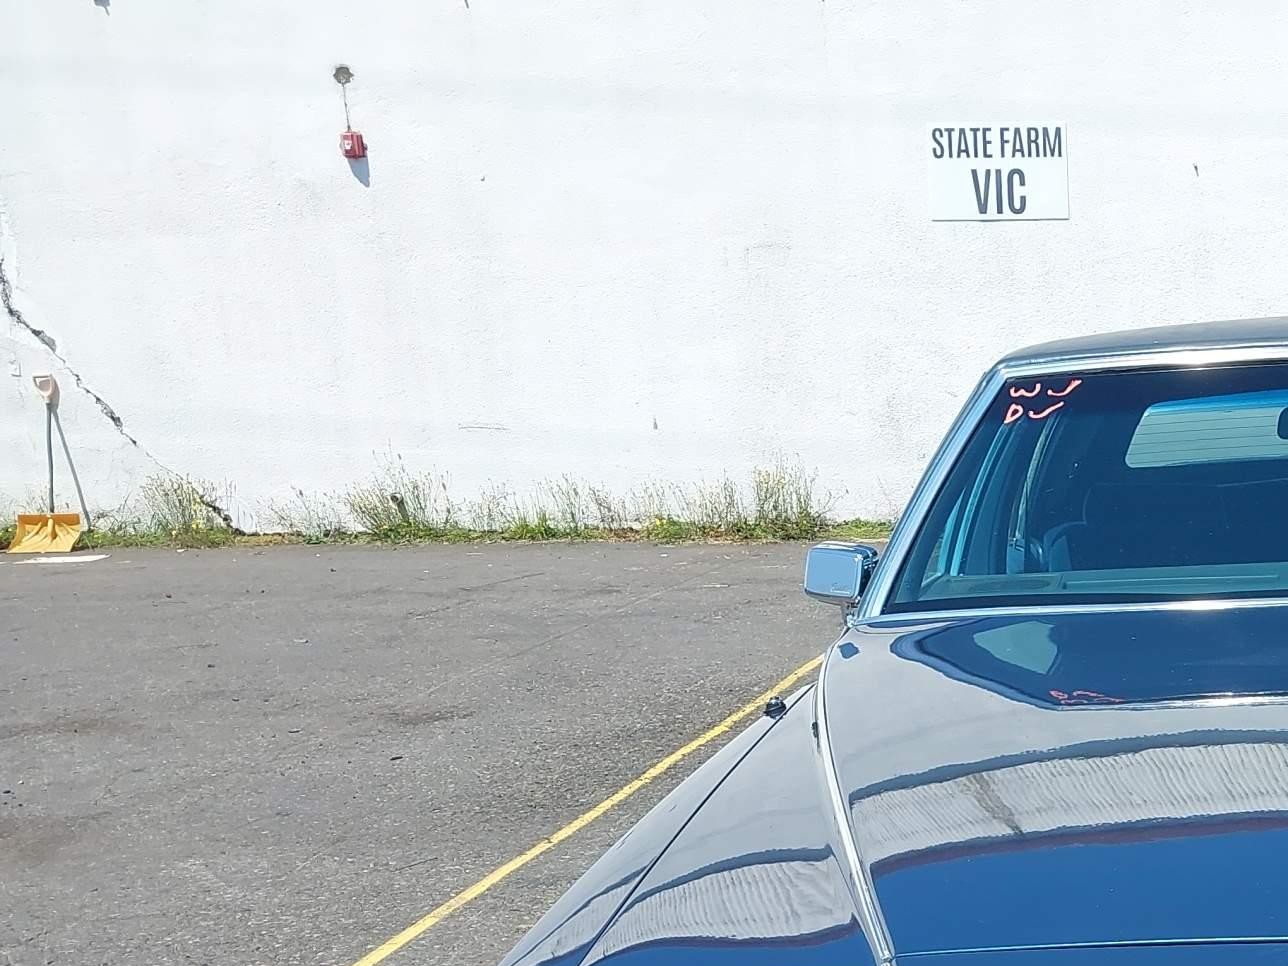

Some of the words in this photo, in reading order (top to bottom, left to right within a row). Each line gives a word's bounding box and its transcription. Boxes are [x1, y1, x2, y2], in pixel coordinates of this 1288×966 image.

[931, 127, 993, 159] STATE
[1000, 127, 1063, 158] FARM
[971, 168, 1027, 214] VIC
